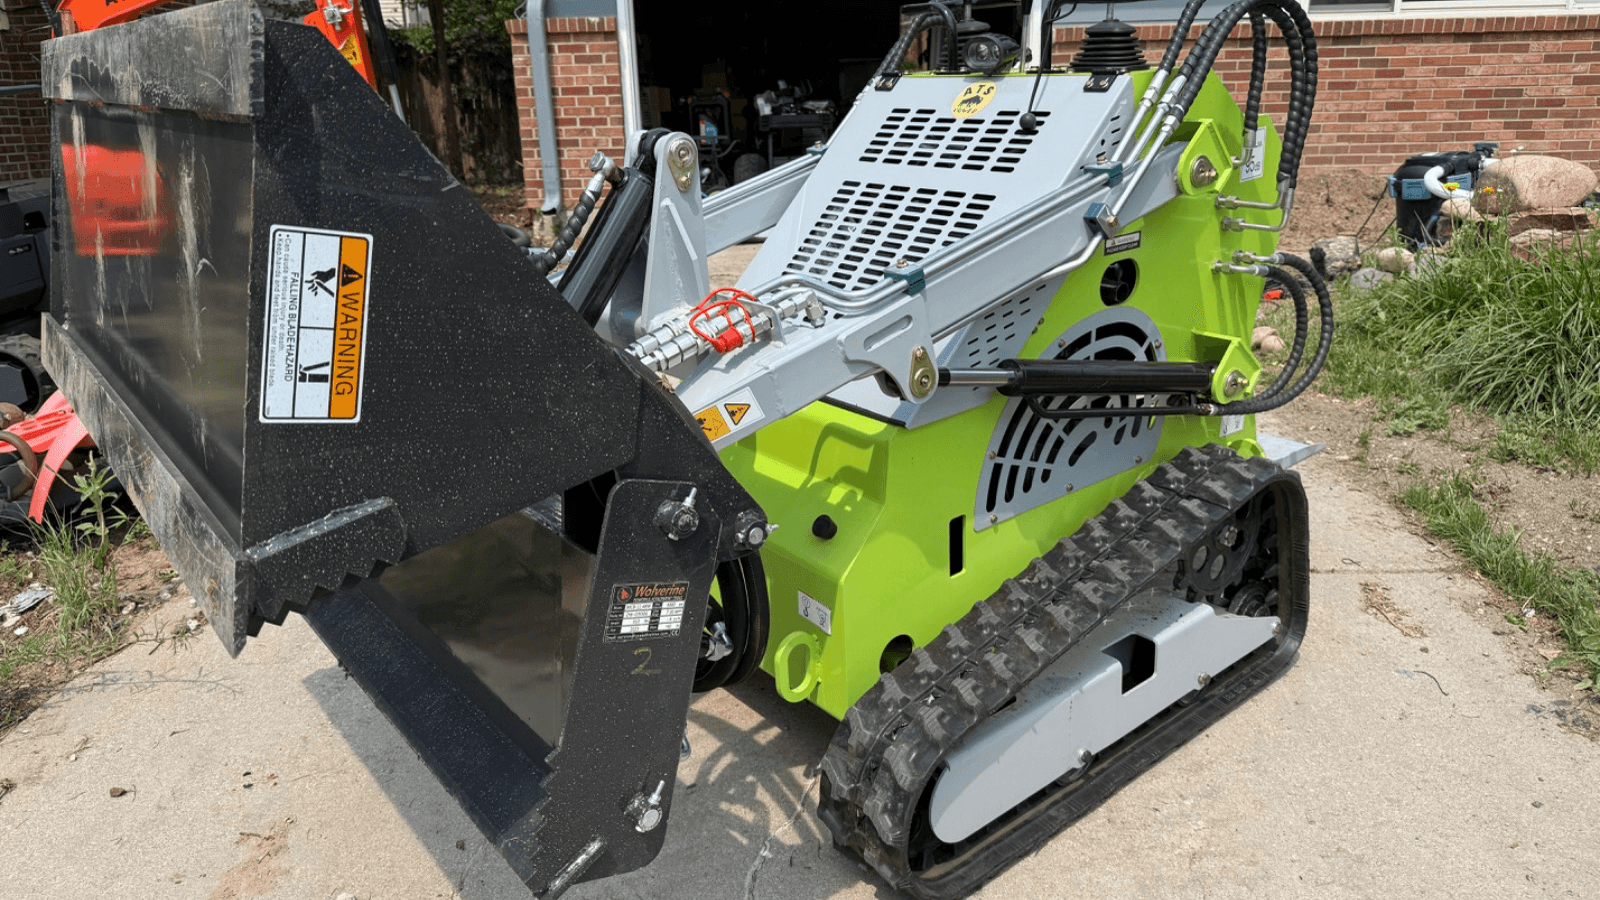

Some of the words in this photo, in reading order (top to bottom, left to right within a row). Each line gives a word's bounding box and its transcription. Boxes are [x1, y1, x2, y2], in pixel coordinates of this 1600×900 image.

[963, 84, 994, 97] ATS
[275, 257, 283, 278] hands
[281, 276, 289, 300] serious
[288, 271, 300, 311] FALLING
[272, 308, 280, 324] from
[279, 302, 287, 321] injury
[271, 325, 279, 345] under
[335, 291, 361, 396] WARNING
[269, 347, 277, 367] raised
[635, 584, 686, 598] Wolverine
[630, 646, 662, 676] 2
